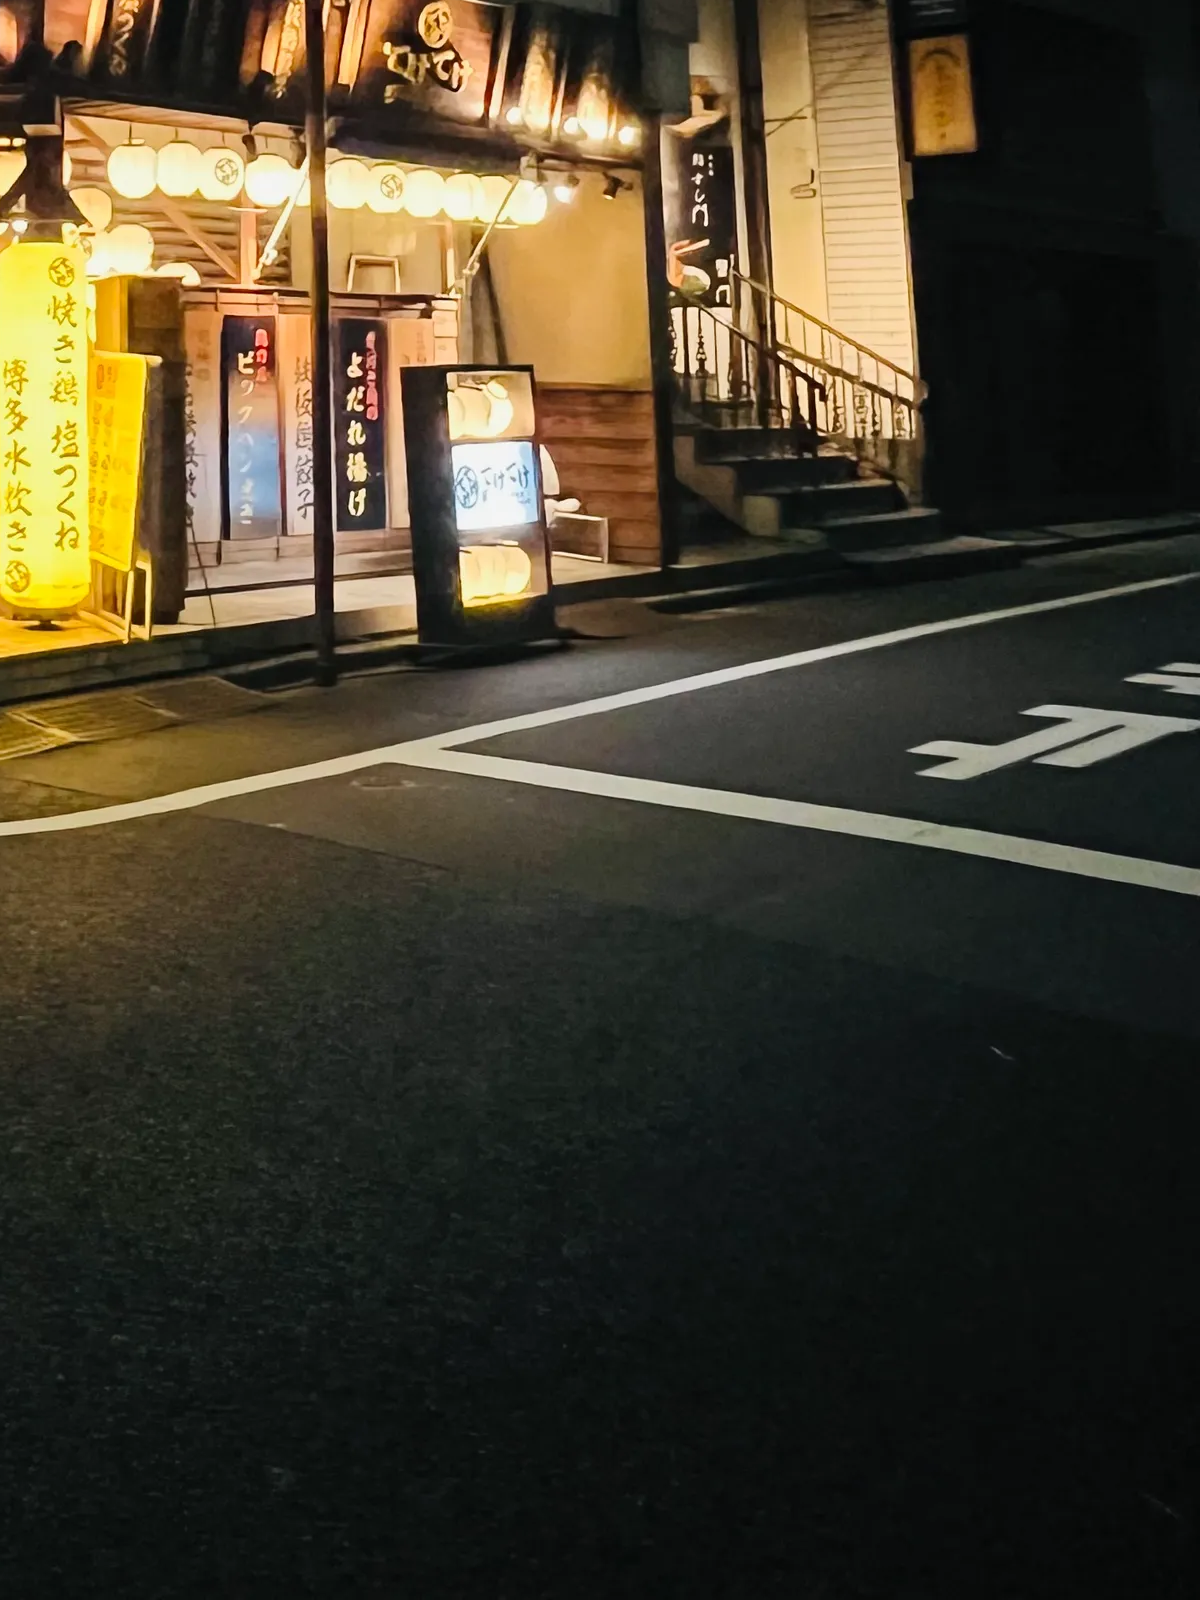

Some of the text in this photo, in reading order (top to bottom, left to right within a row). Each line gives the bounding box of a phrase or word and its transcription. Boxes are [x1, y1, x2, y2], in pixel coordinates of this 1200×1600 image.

[3, 360, 33, 553] 博多水炊き
